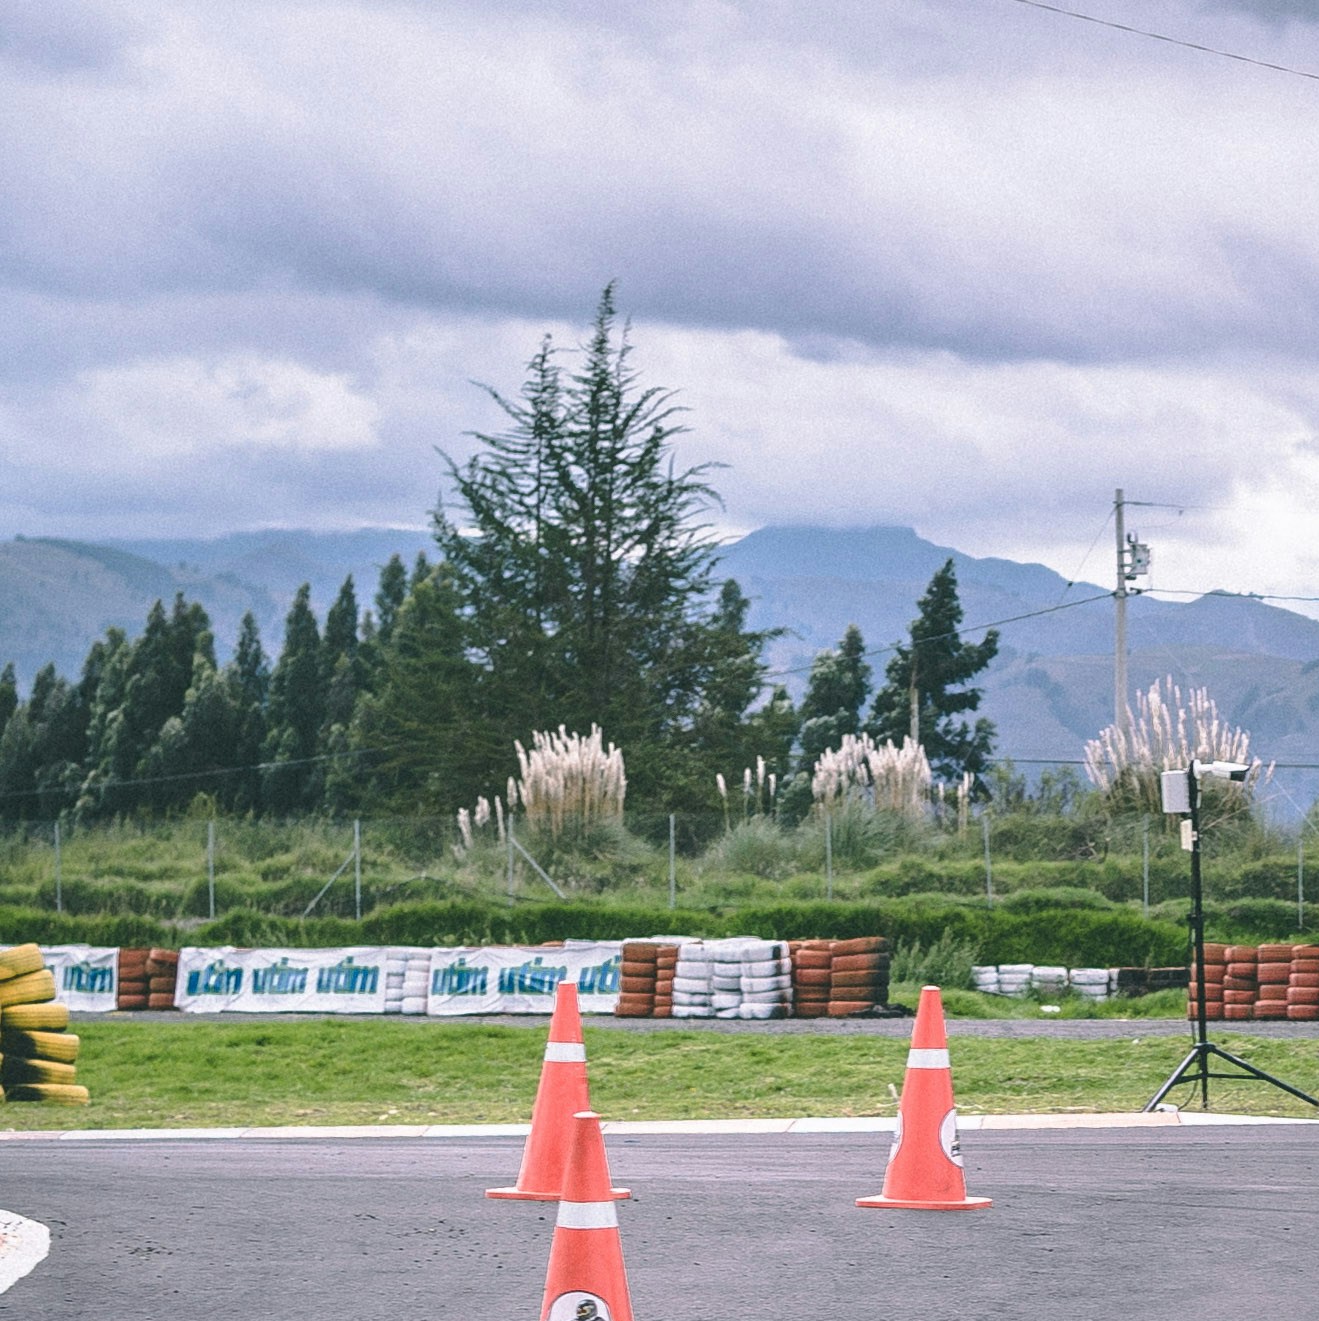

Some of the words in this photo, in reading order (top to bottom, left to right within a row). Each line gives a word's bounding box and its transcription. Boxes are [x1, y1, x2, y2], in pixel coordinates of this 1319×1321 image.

[252, 957, 309, 995] utim
[316, 955, 379, 994] utim
[430, 957, 489, 995] utim
[499, 956, 567, 996] utim
[578, 954, 622, 995] uti
